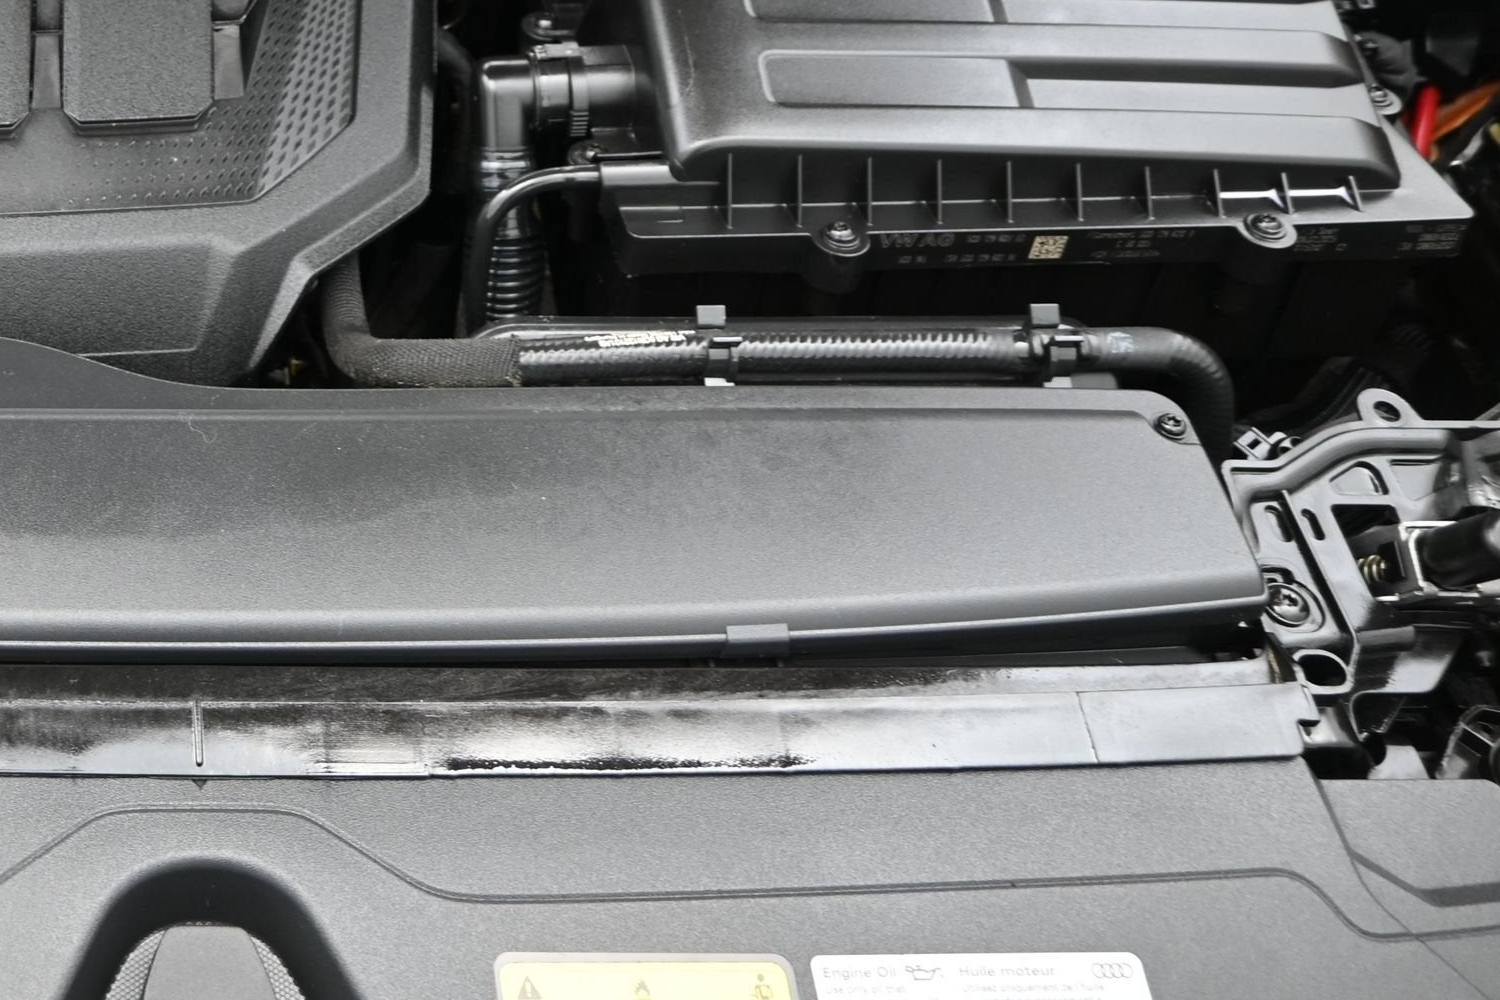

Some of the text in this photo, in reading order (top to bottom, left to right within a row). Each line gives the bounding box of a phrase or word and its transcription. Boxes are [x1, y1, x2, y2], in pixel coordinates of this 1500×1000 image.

[823, 966, 896, 981] Engine Oil
[958, 966, 1055, 978] Huile moteur
